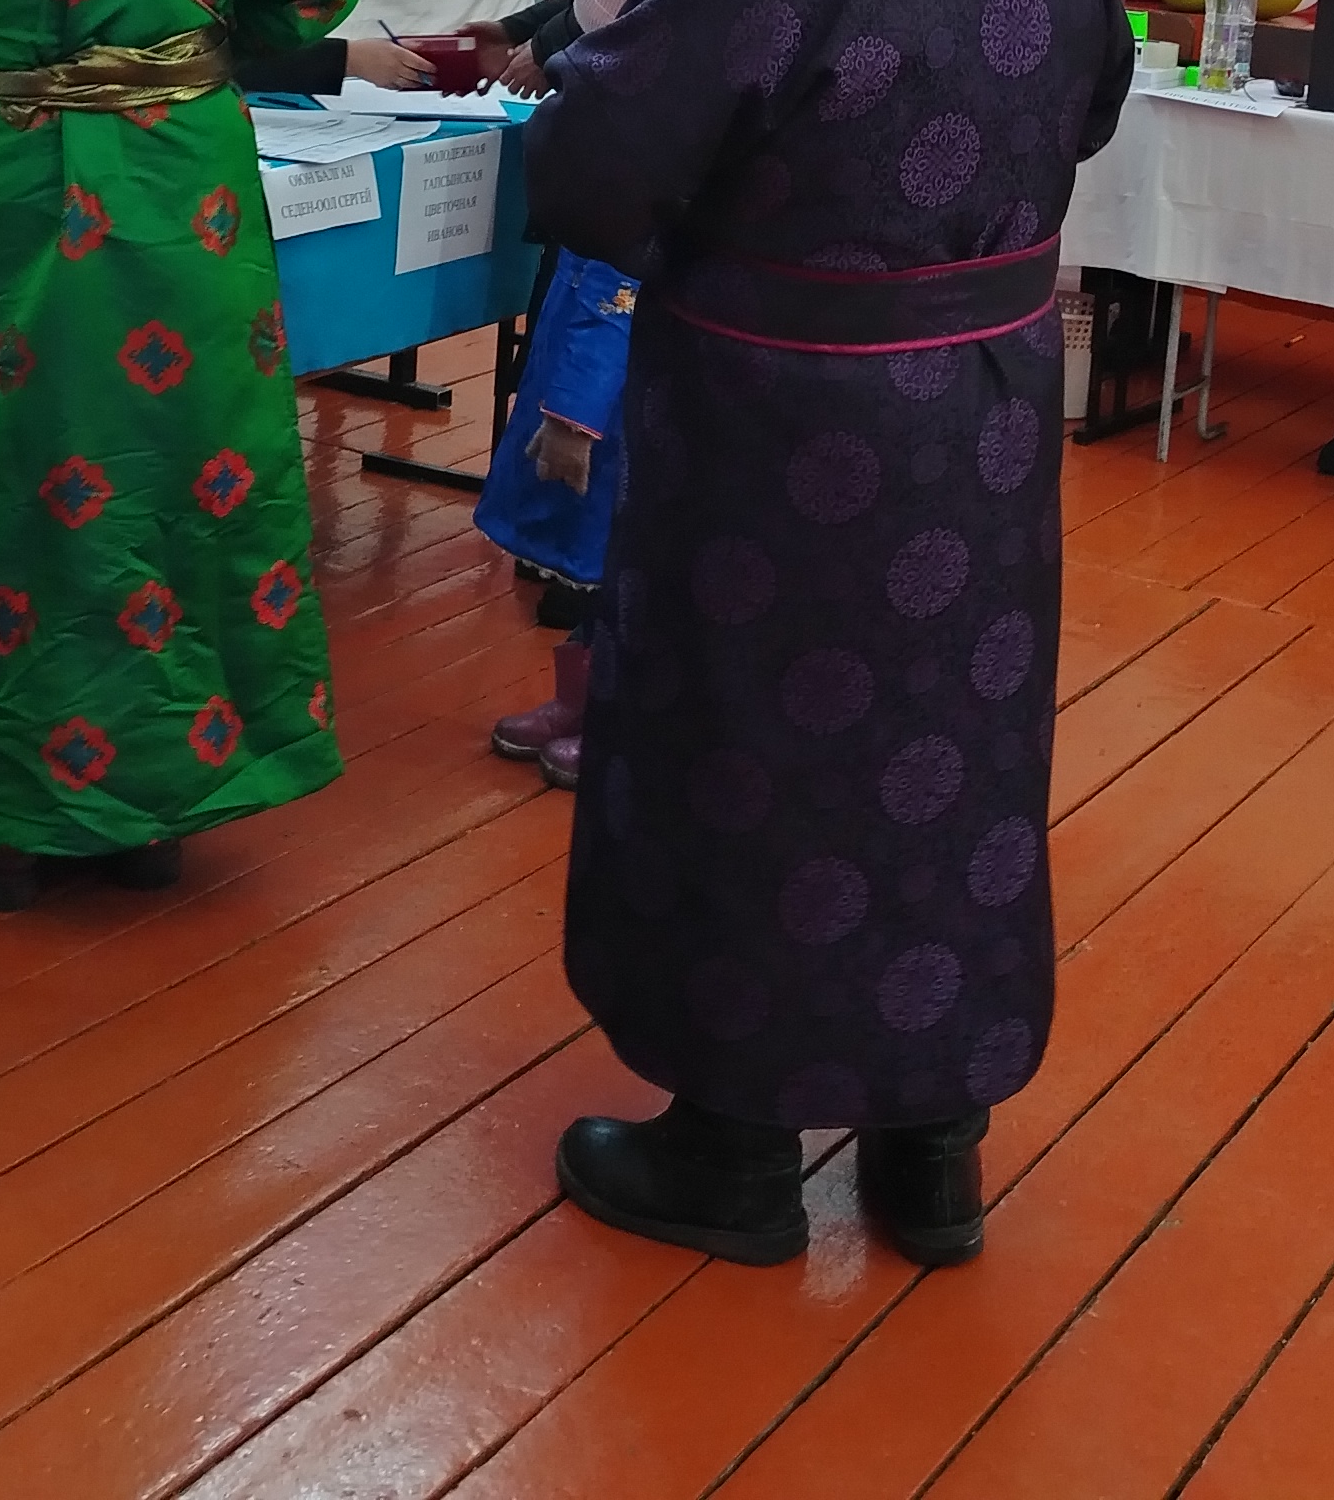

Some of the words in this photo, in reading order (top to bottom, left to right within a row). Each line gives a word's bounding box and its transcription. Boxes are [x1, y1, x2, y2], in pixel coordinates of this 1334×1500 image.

[423, 142, 486, 164] МОЛОДЕЖНАЯ
[281, 196, 337, 219] СЕДЕН-ООЛ
[337, 187, 372, 210] СЕРГЕЙ
[424, 195, 477, 217] ЦВЕТОЧНАЯ
[427, 224, 469, 242] ИВАНОВА
